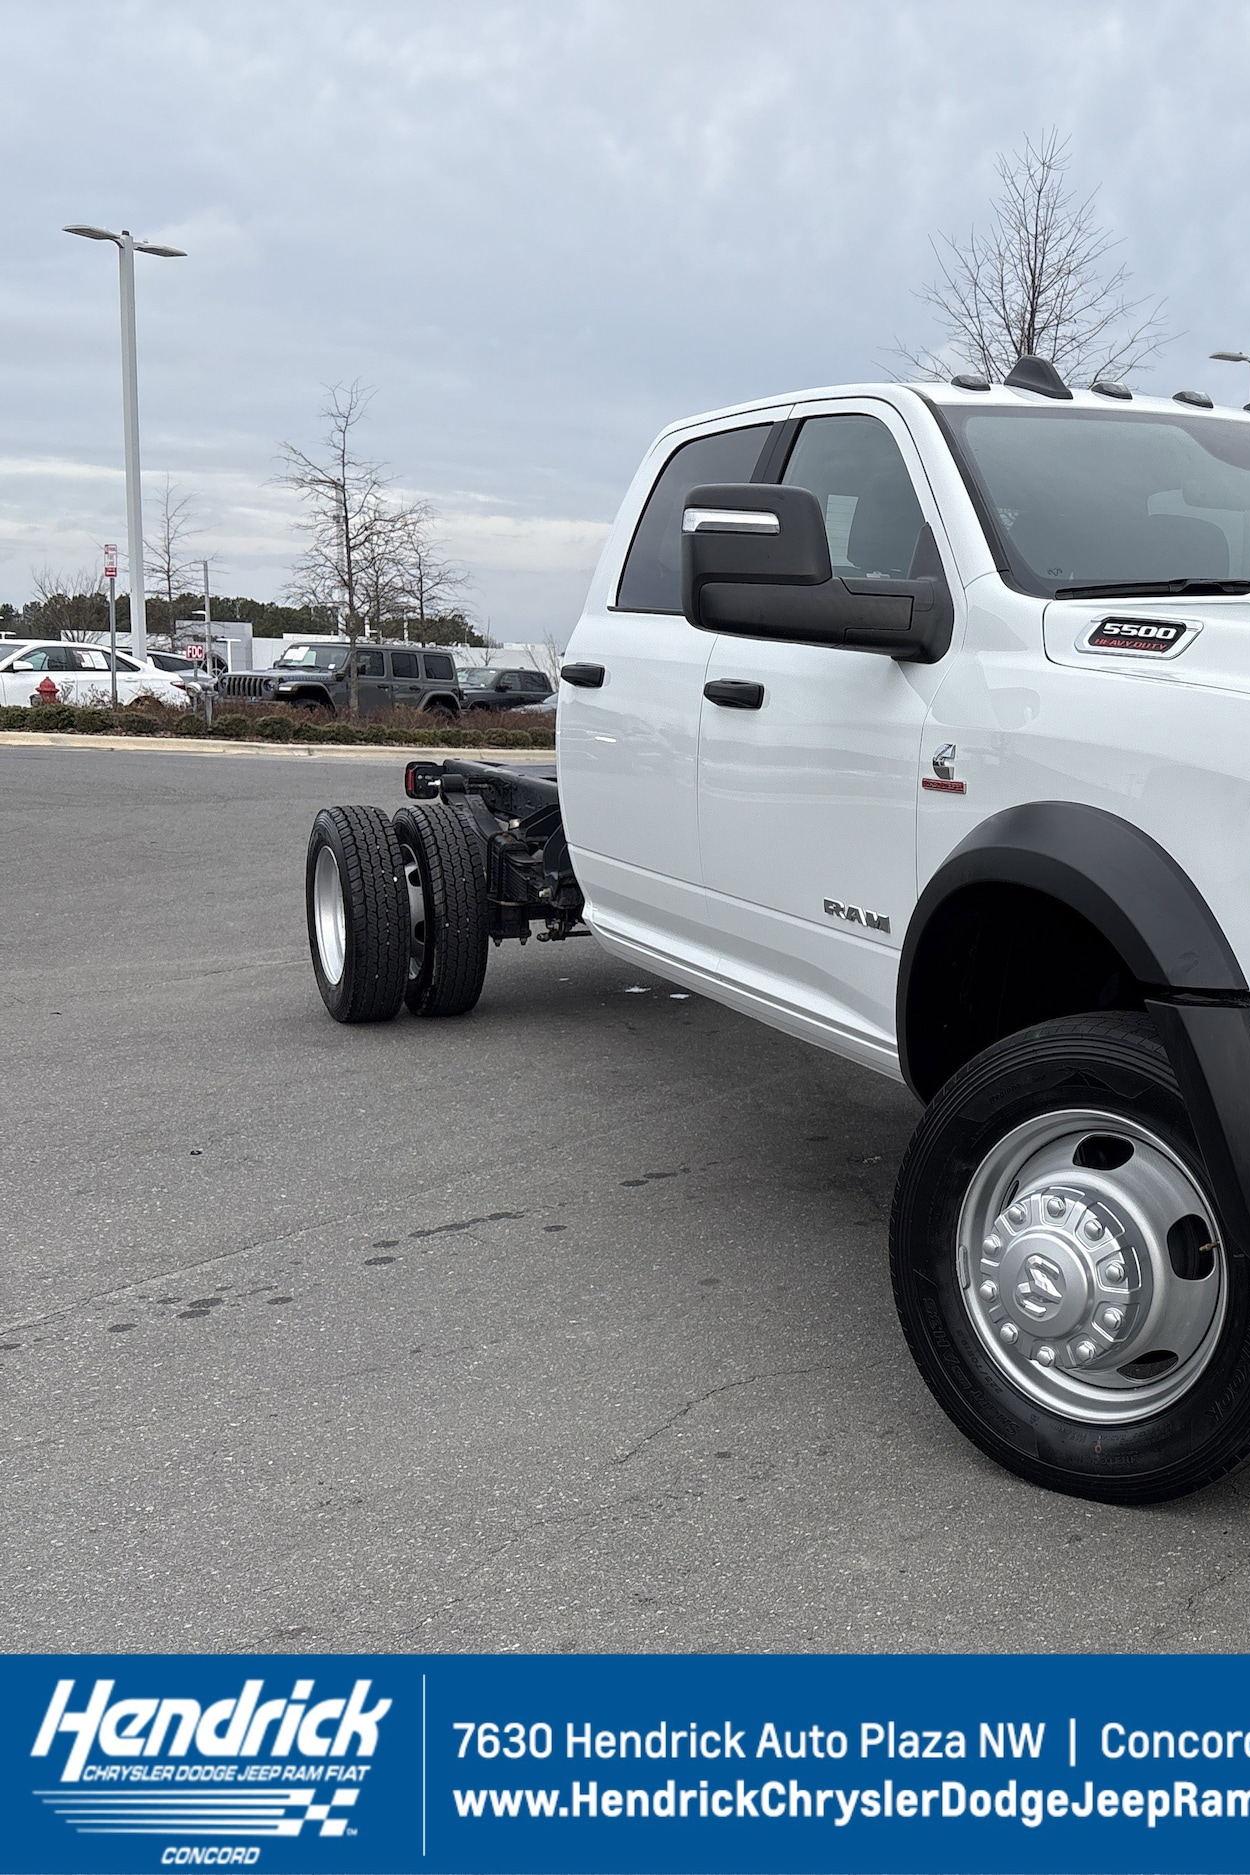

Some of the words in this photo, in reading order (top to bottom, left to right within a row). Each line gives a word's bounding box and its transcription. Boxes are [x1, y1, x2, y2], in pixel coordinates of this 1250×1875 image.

[1102, 622, 1177, 640] 5500
[187, 645, 203, 658] FDC
[1095, 639, 1134, 647] HEAVY
[1133, 641, 1168, 650] DUTY
[823, 896, 891, 934] RAM
